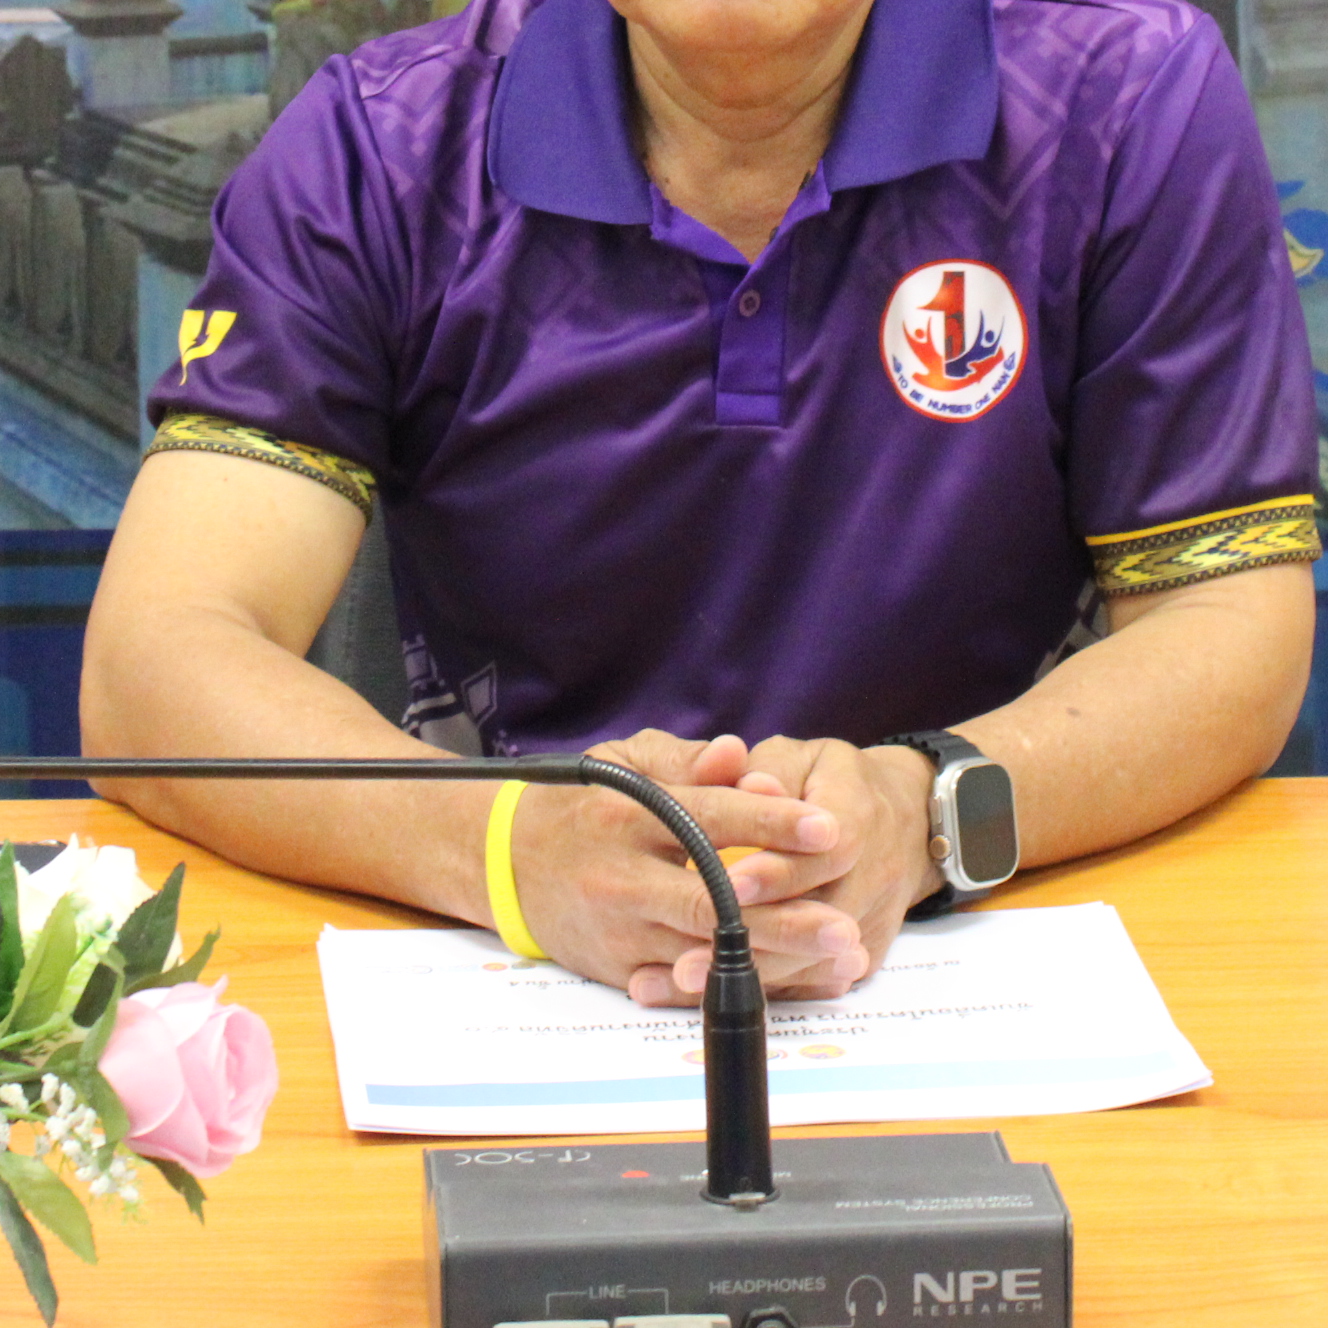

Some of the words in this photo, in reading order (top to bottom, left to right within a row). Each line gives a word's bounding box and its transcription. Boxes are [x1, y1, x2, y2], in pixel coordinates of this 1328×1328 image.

[589, 1284, 626, 1300] LINE
[708, 1276, 826, 1295] HEADPHONES
[913, 1268, 1042, 1303] NPE
[912, 1302, 1043, 1317] RESEARCH
